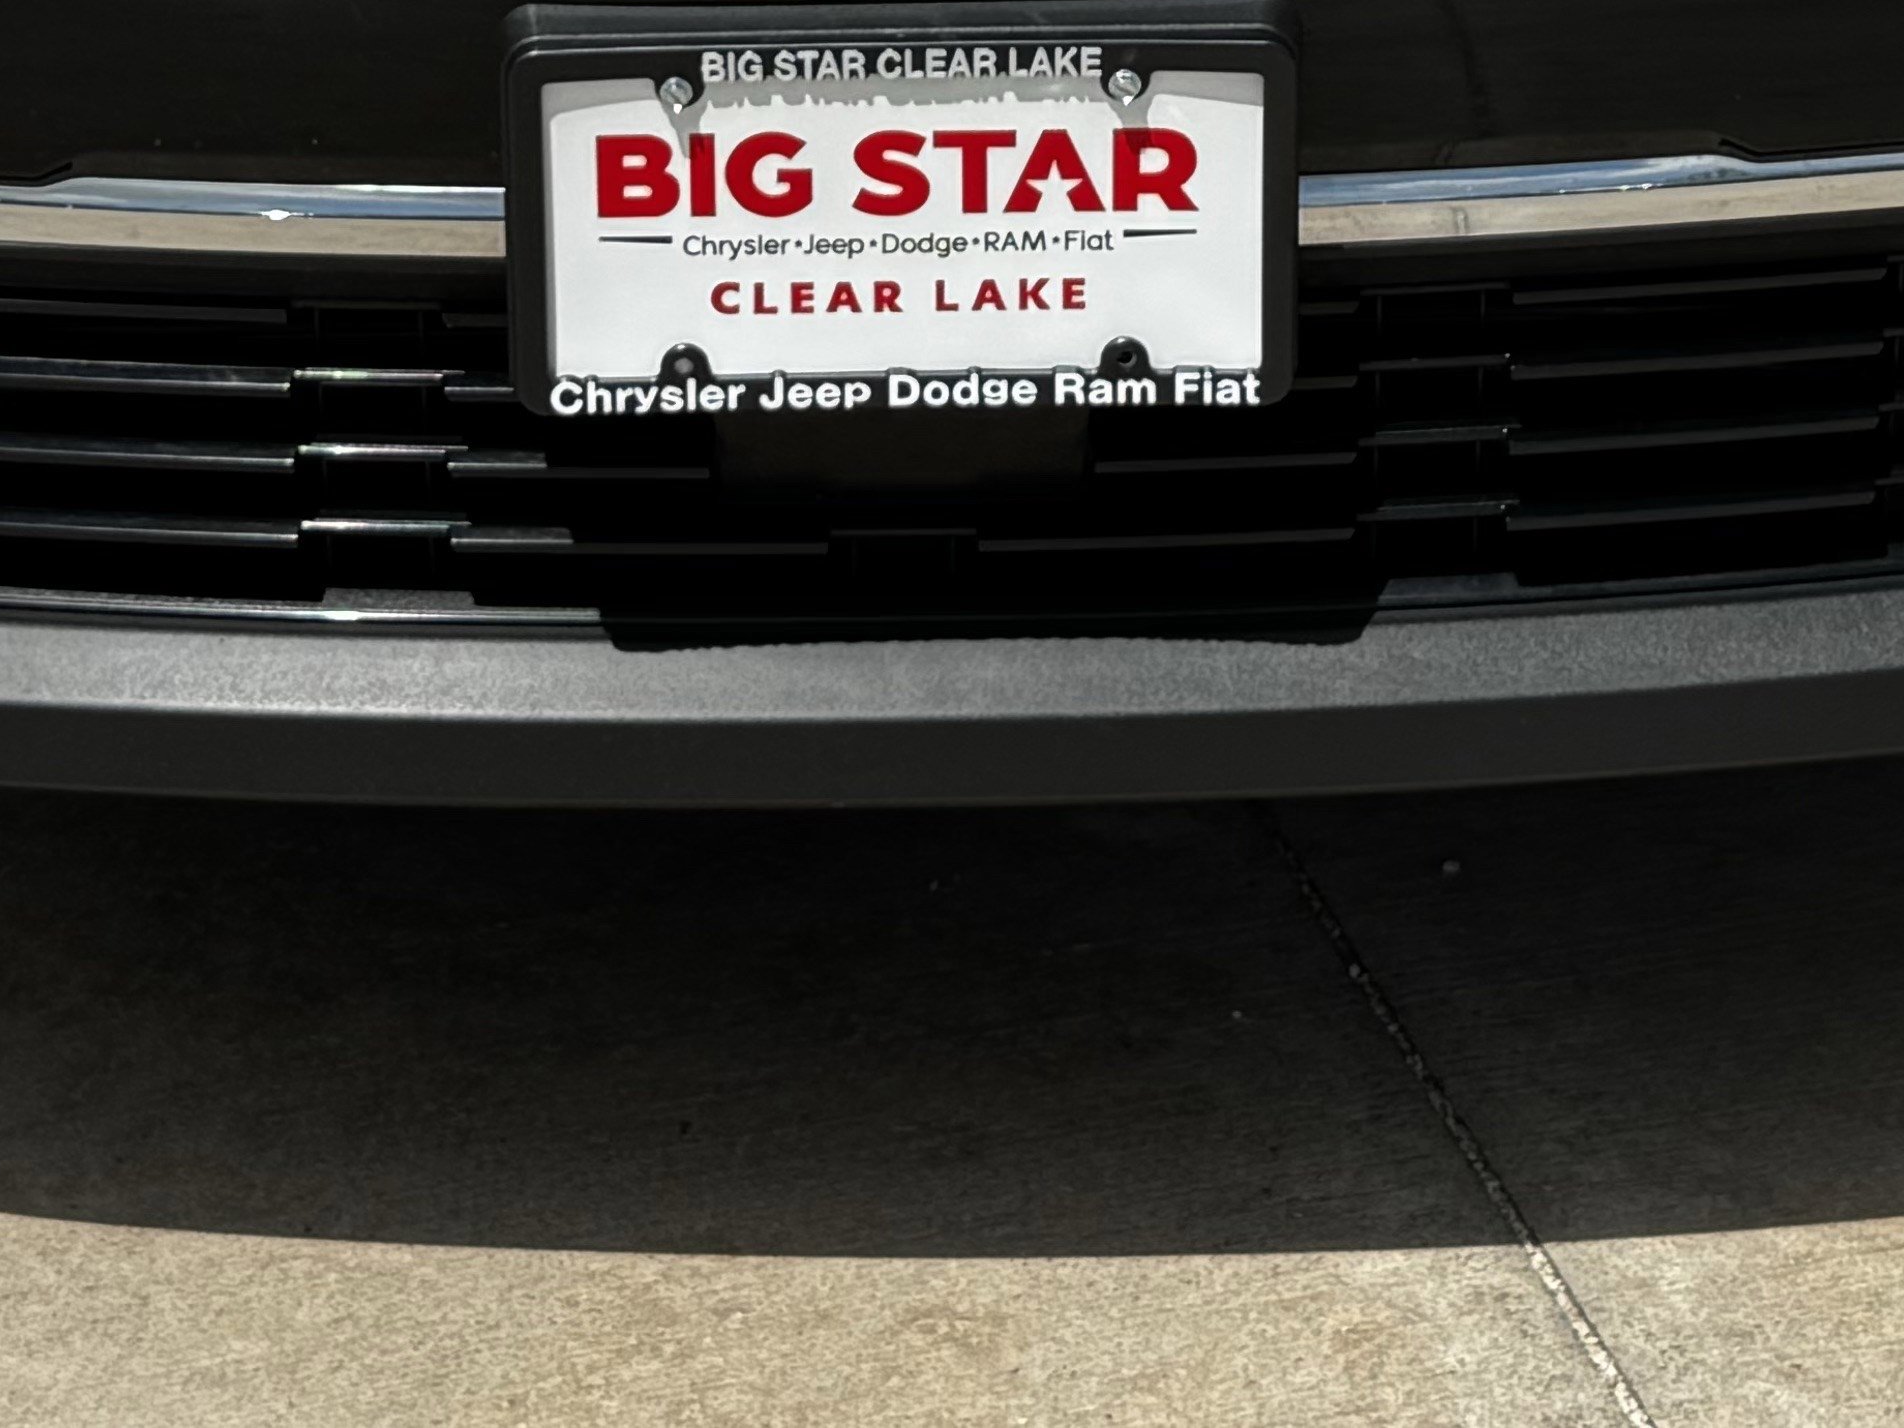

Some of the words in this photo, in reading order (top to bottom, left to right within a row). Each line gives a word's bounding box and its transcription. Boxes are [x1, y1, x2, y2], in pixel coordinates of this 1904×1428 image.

[701, 50, 764, 83] BIG
[774, 49, 866, 82] STAR
[876, 47, 997, 80] CLEAR
[1008, 46, 1103, 78] LAKE
[595, 132, 814, 219] BIG
[853, 128, 1199, 217] STAR
[682, 234, 791, 261] Chrysler
[803, 234, 866, 259] Jeep
[881, 232, 969, 258] Dodge
[984, 230, 1048, 252] RAM
[1064, 230, 1115, 251] Fiat
[710, 281, 904, 315] CLEAR
[934, 277, 1087, 312] LAKE
[549, 377, 747, 416] Chrysler
[758, 376, 873, 411] Jeep
[887, 374, 1039, 408] Dodge
[1053, 373, 1158, 407] Ram
[1173, 372, 1262, 406] Fiat
